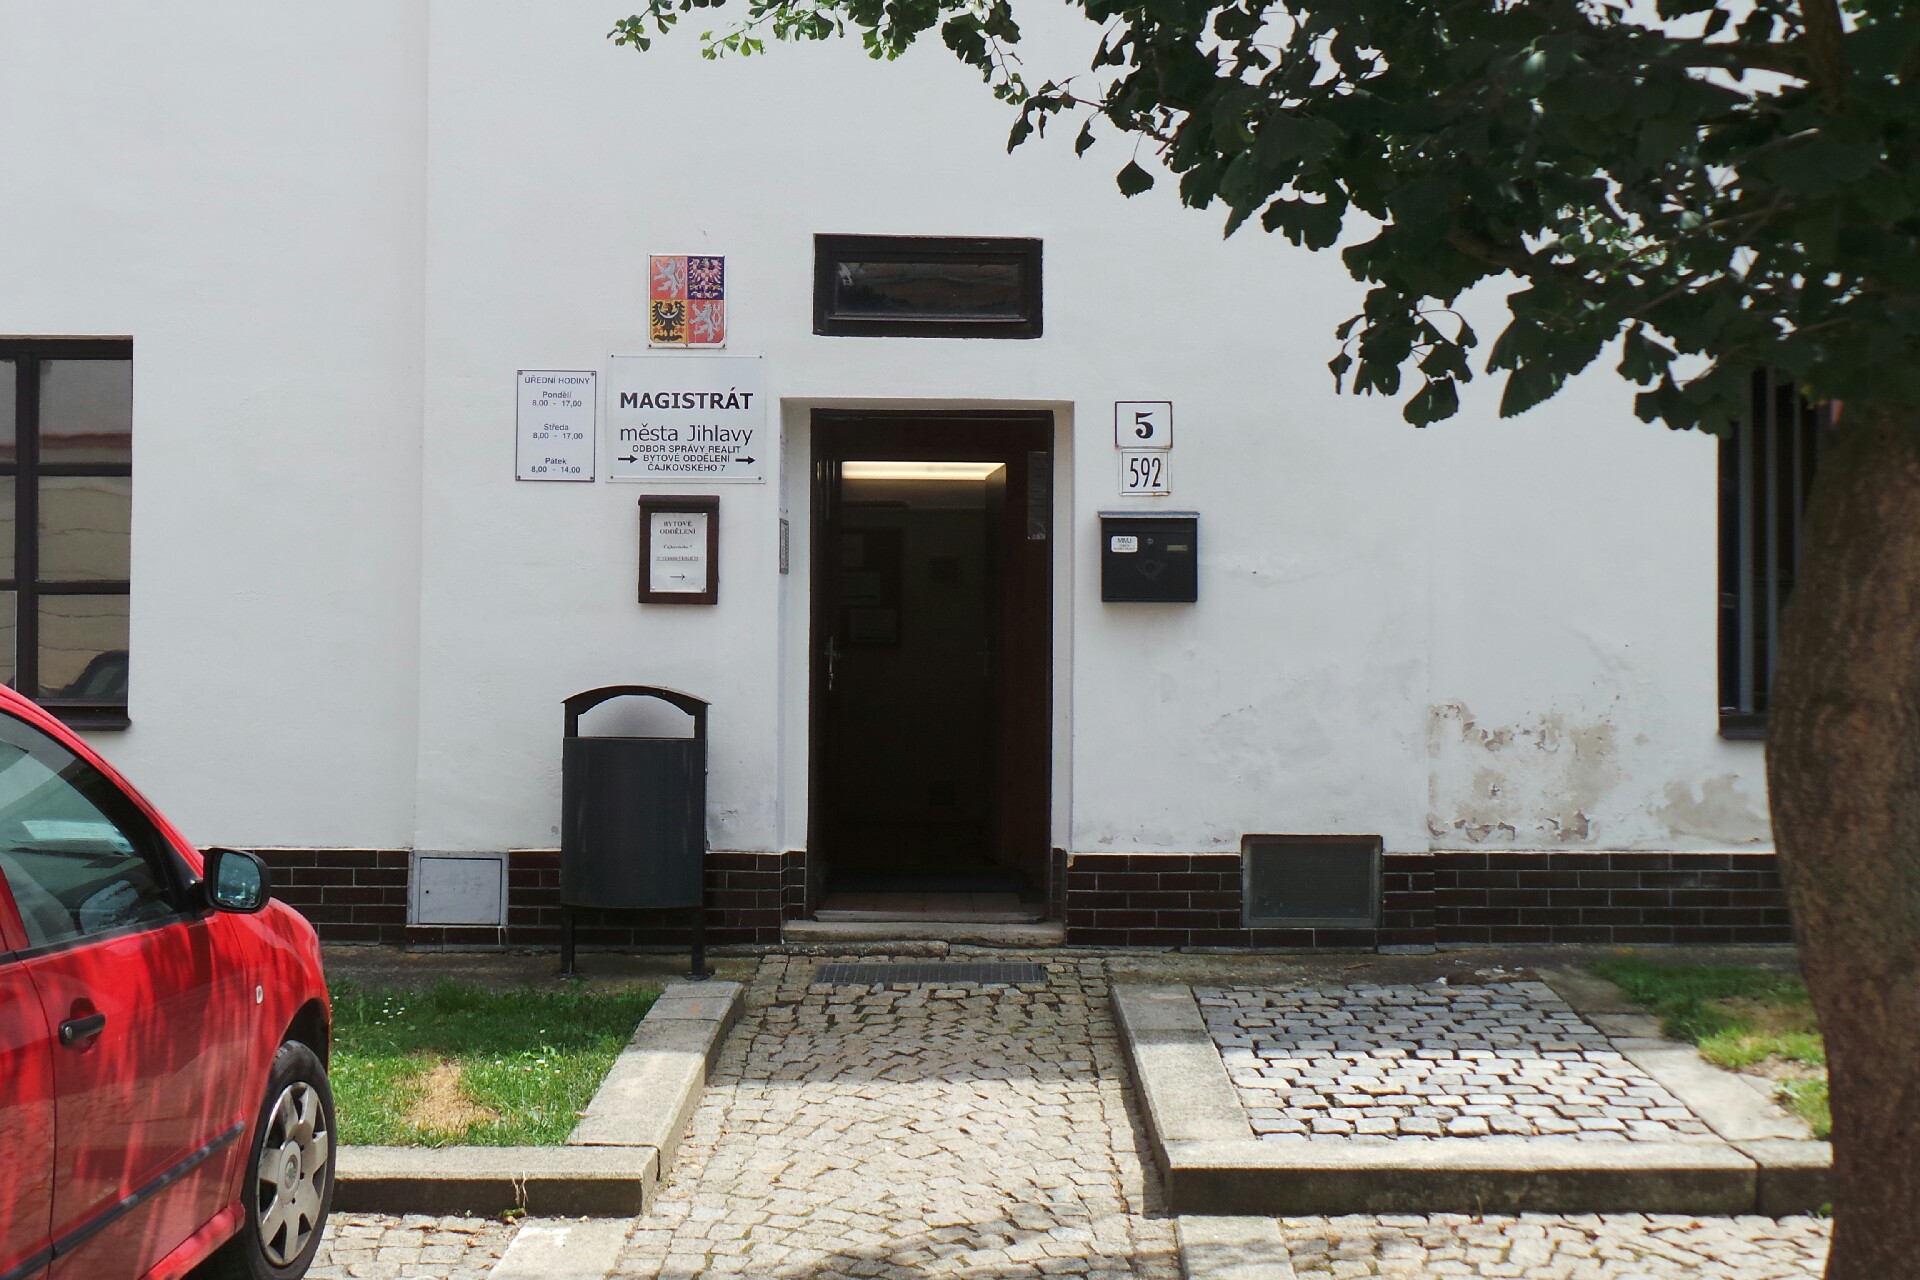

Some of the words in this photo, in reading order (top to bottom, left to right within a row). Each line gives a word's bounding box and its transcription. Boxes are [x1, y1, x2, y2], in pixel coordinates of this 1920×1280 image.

[558, 377, 590, 385] HODINY
[542, 391, 572, 399] Pondělí
[620, 387, 754, 410] MAGISTRÁT
[562, 400, 582, 408] 17,00
[543, 423, 569, 431] Středa
[1135, 412, 1154, 439] 5
[562, 433, 583, 441] 17,00
[620, 423, 678, 442] města
[687, 425, 753, 446] Jihlavy
[632, 445, 666, 453] ODBOR
[668, 444, 705, 453] SPRÁVY
[708, 446, 741, 454] REALIT
[643, 453, 680, 462] BYTOVÉ
[683, 453, 730, 463] ODDĚLENÍ
[647, 462, 717, 471] ČAJKOVSKÉHO
[720, 464, 726, 472] 7
[1129, 458, 1161, 488] 592
